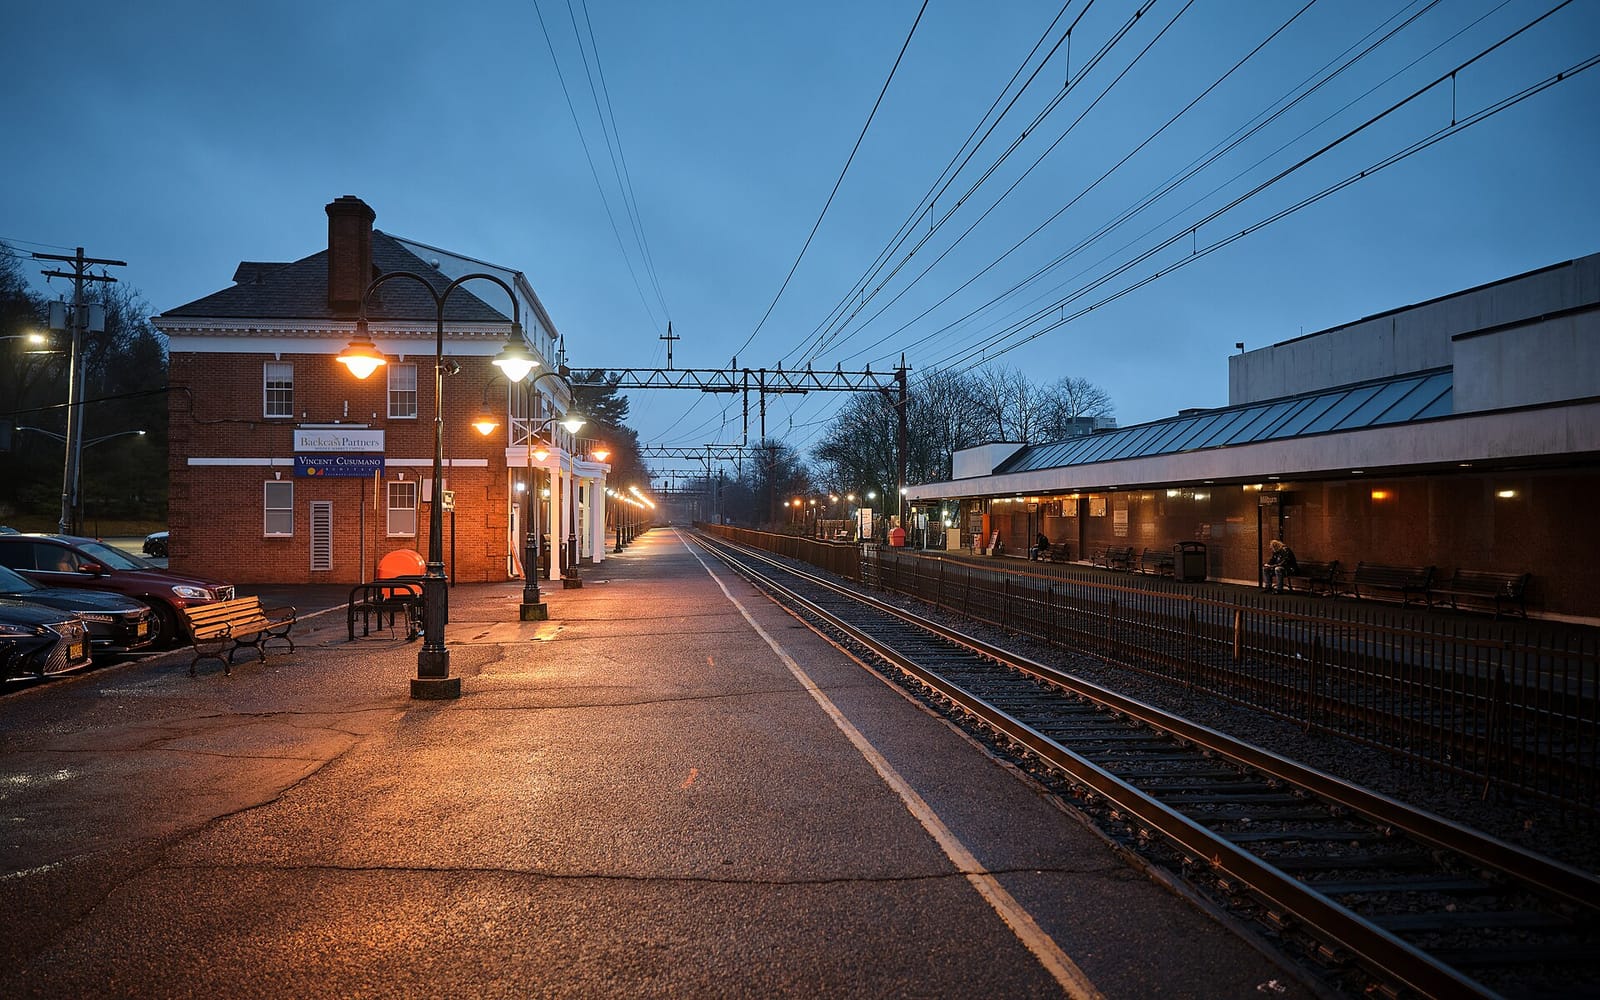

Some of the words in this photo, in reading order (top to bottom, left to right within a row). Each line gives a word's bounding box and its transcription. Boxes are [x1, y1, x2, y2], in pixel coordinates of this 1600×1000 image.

[342, 437, 379, 447] Partners
[299, 456, 334, 465] VINCENT
[336, 456, 381, 465] CUSUMANO
